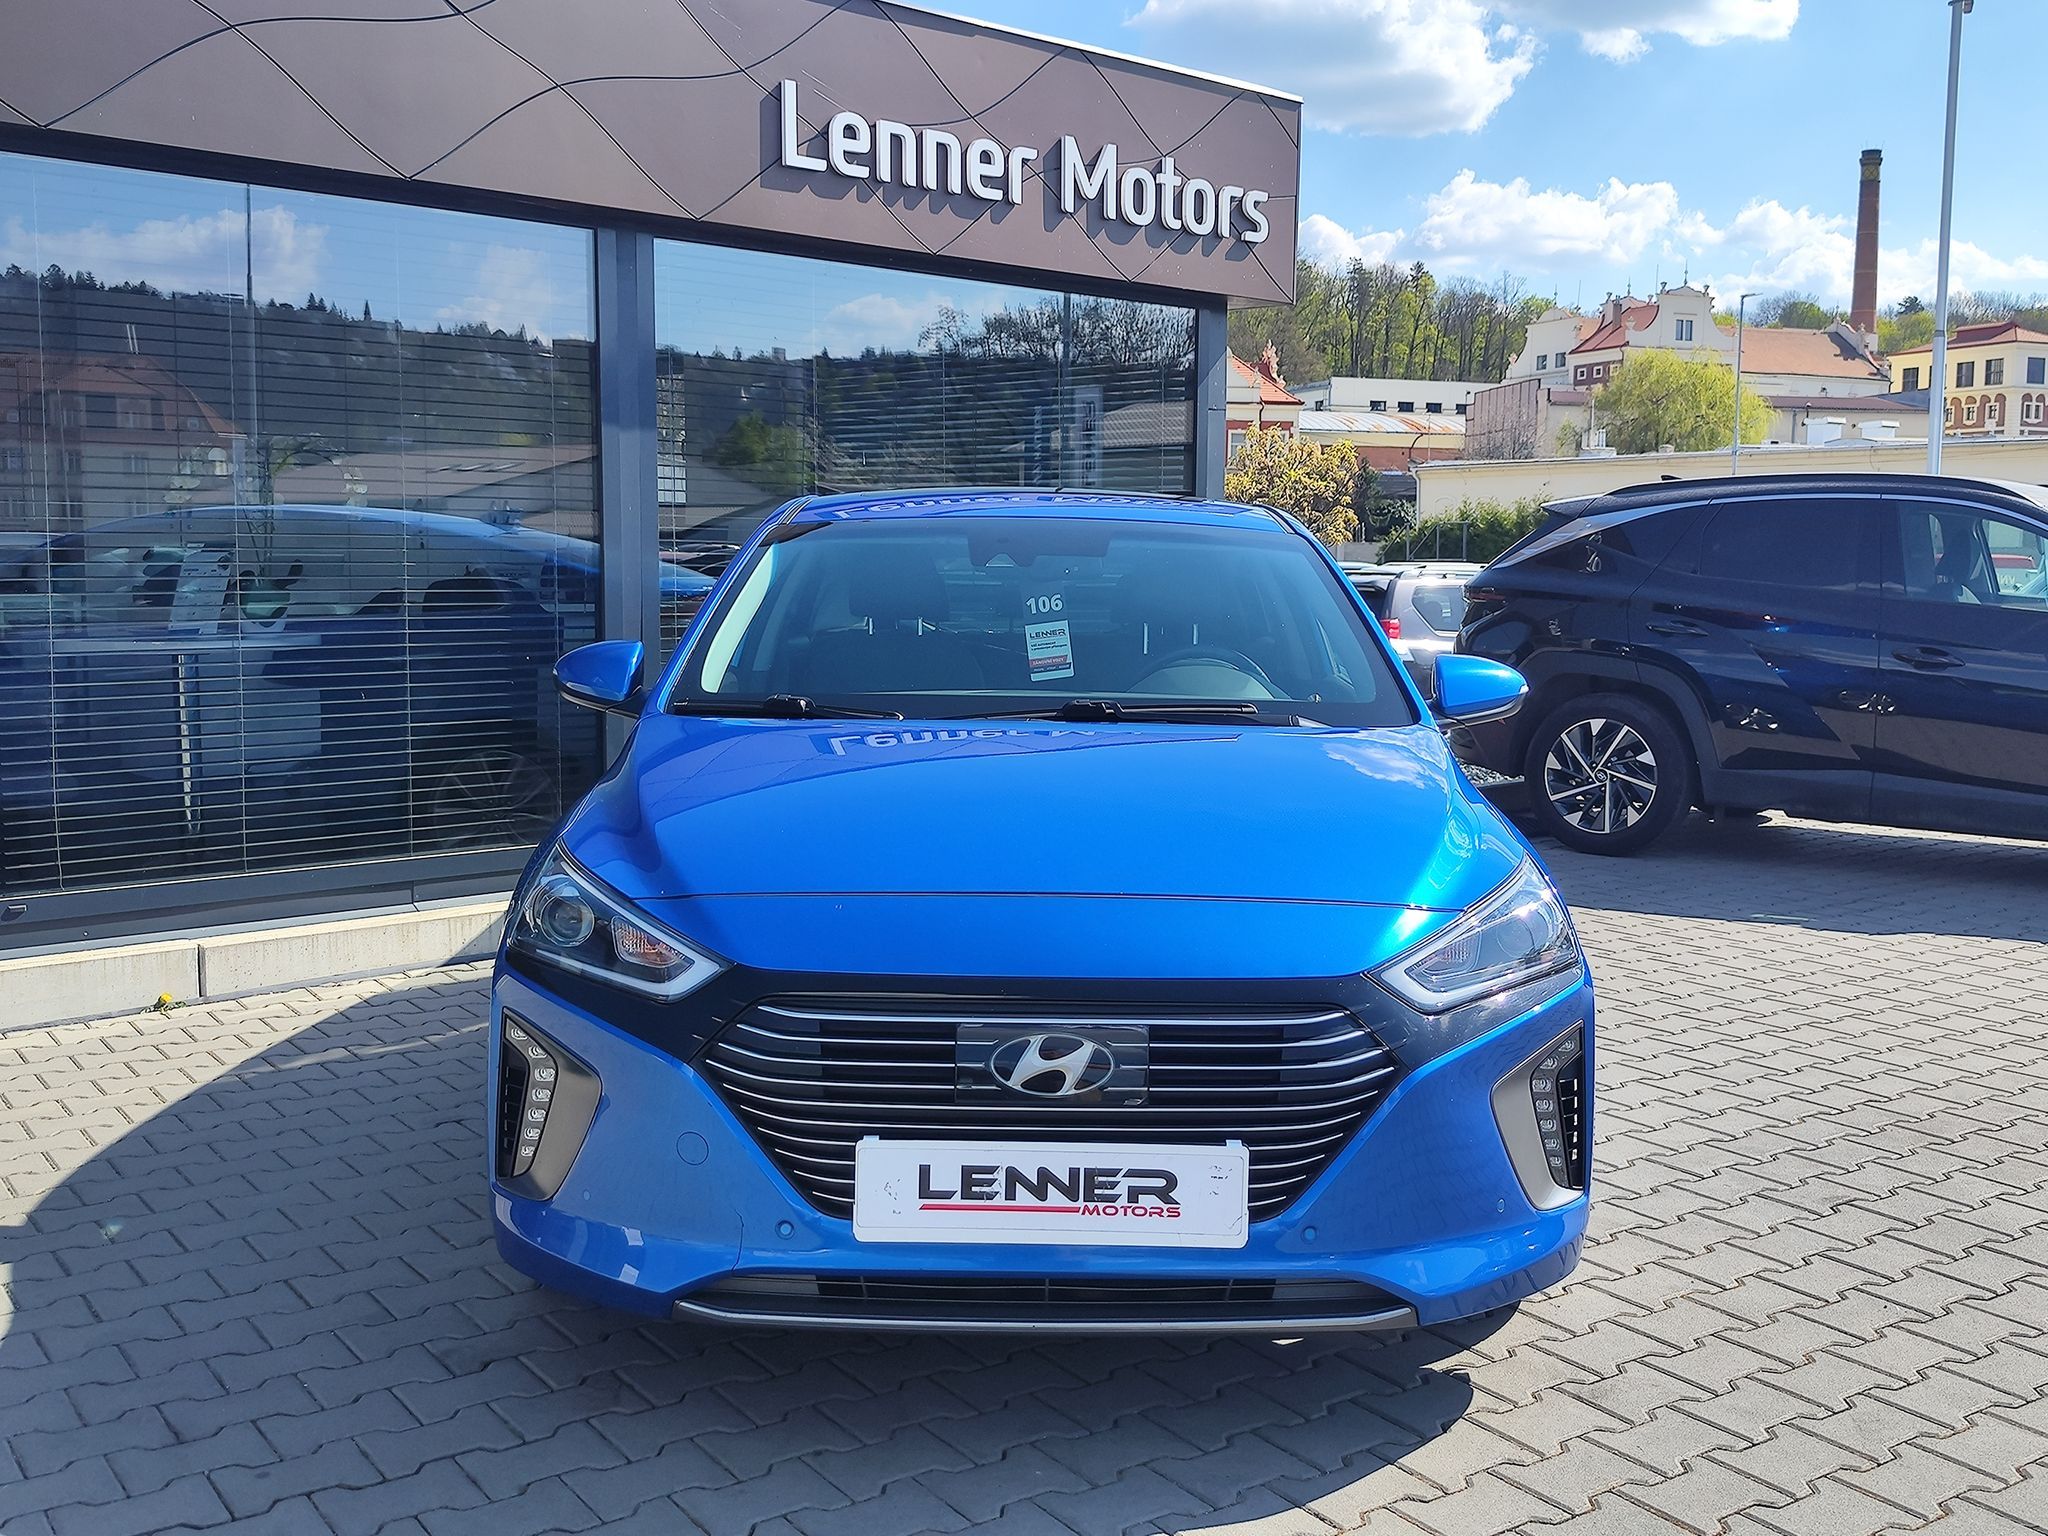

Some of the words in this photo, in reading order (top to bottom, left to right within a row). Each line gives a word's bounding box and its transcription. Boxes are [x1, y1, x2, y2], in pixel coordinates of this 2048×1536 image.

[779, 79, 1038, 205] Lenner
[1060, 134, 1270, 243] Motors
[1026, 594, 1063, 614] 106
[1029, 628, 1067, 639] LENNER
[918, 1163, 1181, 1205] LENNER
[1080, 1204, 1181, 1218] MOTORS
